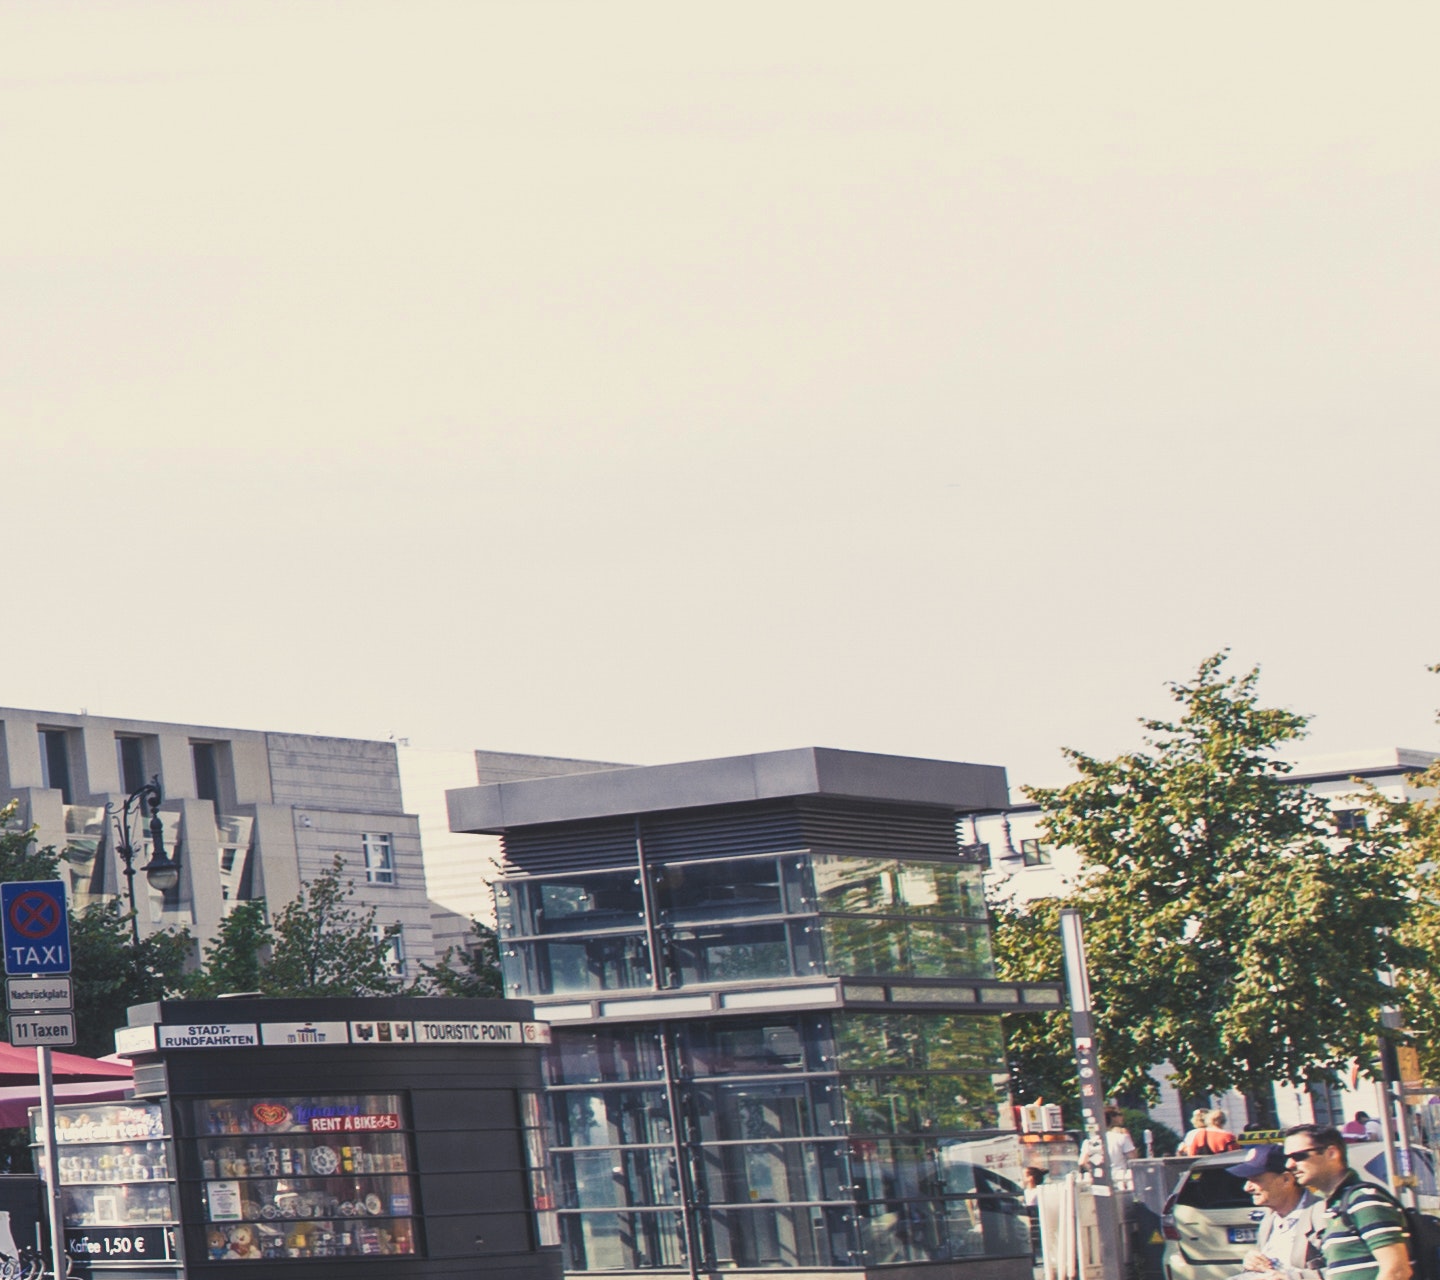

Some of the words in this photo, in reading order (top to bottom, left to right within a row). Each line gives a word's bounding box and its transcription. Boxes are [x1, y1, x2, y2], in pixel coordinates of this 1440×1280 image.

[12, 946, 63, 965] TAXI
[11, 989, 68, 1000] Nachrückplatz
[16, 1024, 28, 1038] 11
[31, 1023, 68, 1037] Taxen
[188, 1026, 230, 1035] STADT-
[423, 1024, 479, 1040] TOURISTIC
[482, 1024, 512, 1040] POINT
[166, 1035, 253, 1046] RUNDFAHRTEN
[312, 1117, 340, 1131] RENT
[344, 1116, 353, 1130] A
[354, 1116, 378, 1129] BIKE
[70, 1237, 101, 1253] Kaffee
[104, 1237, 131, 1255] 1,50
[134, 1237, 146, 1252] €
